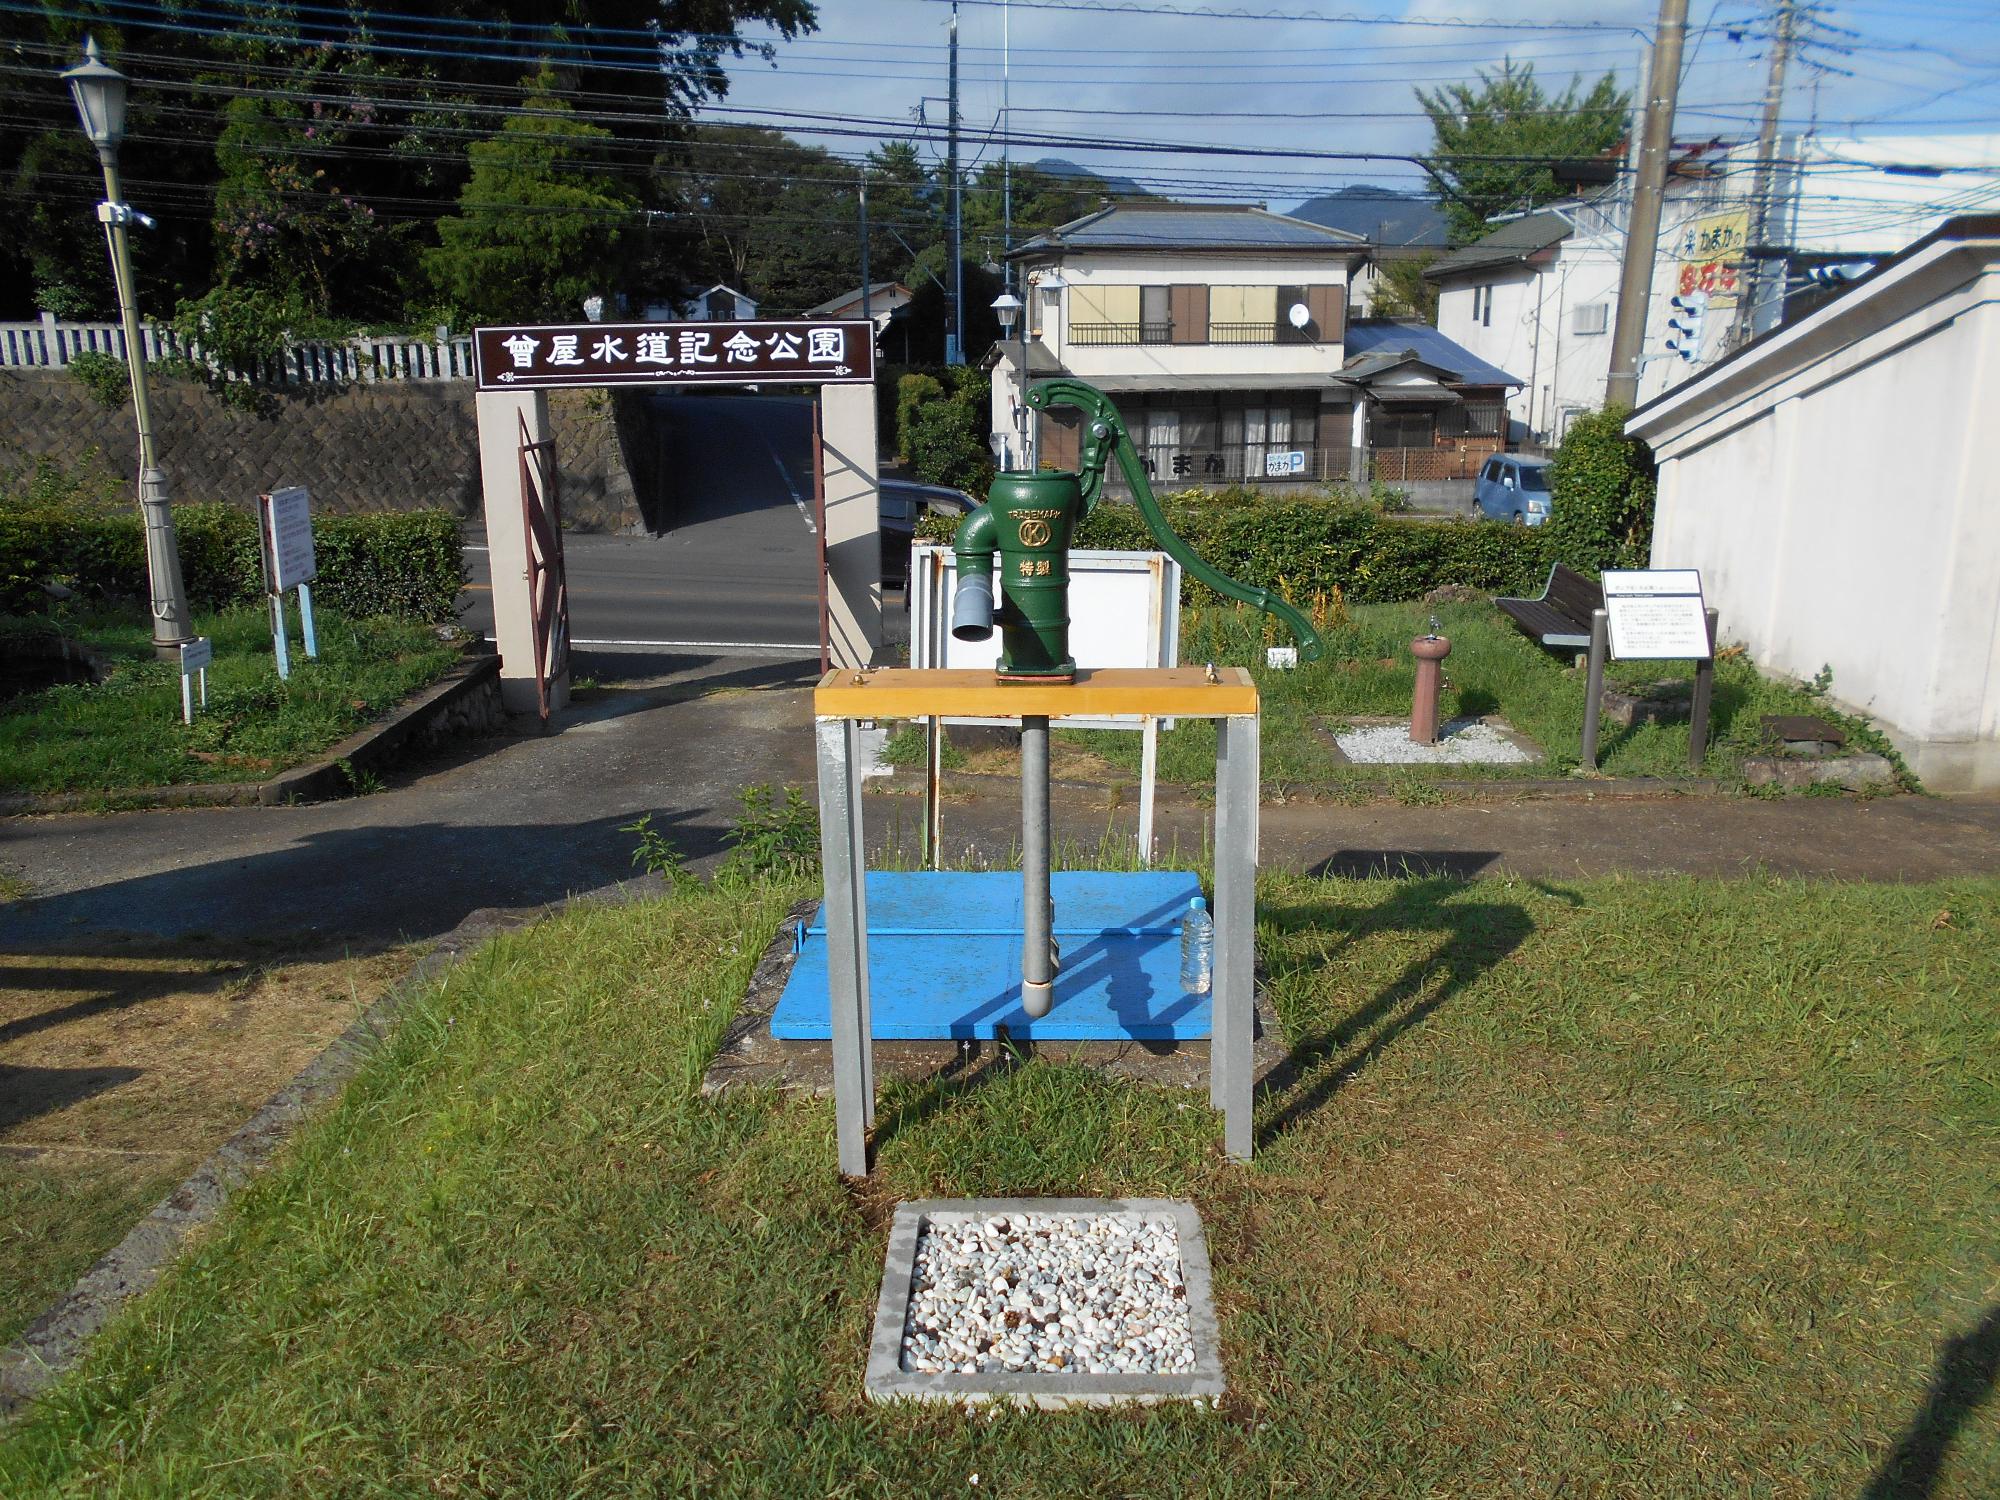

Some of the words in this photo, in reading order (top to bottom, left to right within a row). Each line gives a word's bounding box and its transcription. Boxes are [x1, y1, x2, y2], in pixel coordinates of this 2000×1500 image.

[1268, 461, 1289, 472] かまか
[1290, 453, 1303, 471] P
[1019, 559, 1052, 577] 特製
